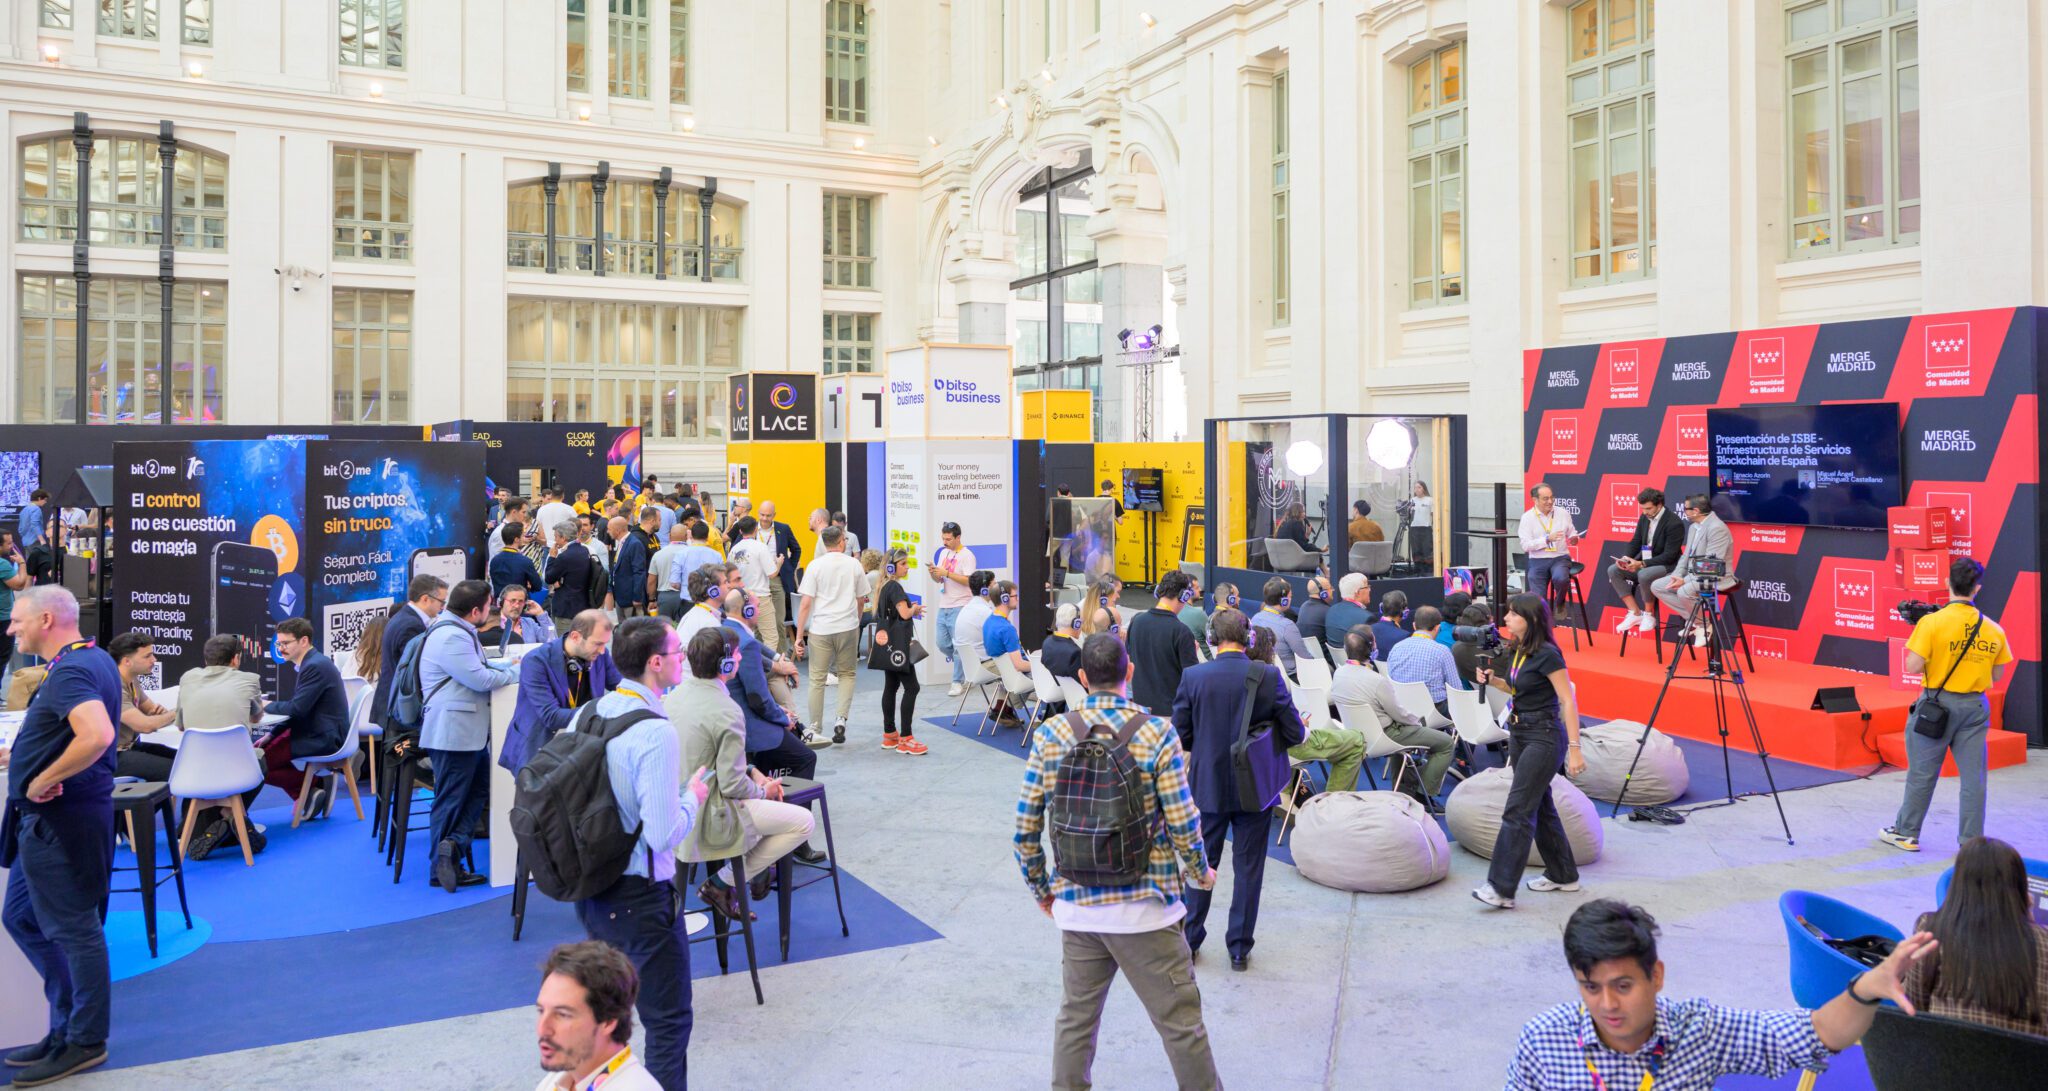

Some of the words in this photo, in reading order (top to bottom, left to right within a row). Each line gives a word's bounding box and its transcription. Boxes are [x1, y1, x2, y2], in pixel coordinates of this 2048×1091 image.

[1830, 351, 1870, 363] MERGE
[1674, 362, 1707, 372] MERGE
[1827, 361, 1876, 373] MADRID
[1549, 370, 1576, 380] MERGE
[1672, 370, 1711, 381] MADRID
[1925, 370, 1970, 378] Comunidad
[897, 381, 912, 393] bitso
[946, 379, 977, 391] bitso
[1547, 378, 1580, 388] MADRID
[1939, 378, 1970, 386] Madrid
[897, 393, 924, 406] business
[946, 393, 1000, 404] business
[733, 416, 748, 431] LACE
[761, 415, 808, 431] LACE
[472, 432, 490, 440] EAD
[566, 431, 595, 440] CLOAK
[1609, 434, 1639, 442] MERGE
[1715, 434, 1776, 444] Presentación
[1777, 434, 1790, 444] de
[1791, 433, 1817, 444] ISBE
[1924, 430, 1970, 441] MERGE
[567, 439, 595, 447] ROOM
[1607, 441, 1643, 451] MADRID
[1921, 440, 1976, 451] MADRID
[1715, 445, 1789, 455] Infraestructura
[1790, 445, 1803, 455] de
[1804, 444, 1851, 455] Servicios
[938, 463, 954, 471] Your
[955, 464, 980, 472] money
[1716, 456, 1766, 466] Blockchain
[1767, 456, 1780, 466] de
[1781, 456, 1818, 468] España
[131, 459, 176, 479] bit2me
[323, 459, 371, 479] bit2me
[938, 473, 969, 482] traveling
[938, 482, 961, 490] LatAm
[962, 482, 976, 490] and
[977, 482, 1003, 491] Europe
[131, 493, 144, 507] El
[146, 493, 201, 508] control
[324, 494, 351, 510] Tus
[353, 492, 408, 510] criptos.
[962, 492, 981, 500] time.
[131, 518, 149, 531] no
[152, 517, 169, 531] es
[172, 514, 236, 532] cuestión
[324, 517, 347, 534] sin
[349, 517, 394, 532] truco.
[1751, 528, 1786, 536] Comunidad
[1762, 536, 1786, 544] Madrid
[131, 538, 150, 554] de
[152, 538, 197, 557] magia
[1949, 548, 1972, 556] adrid
[324, 554, 367, 570] Seguro.
[323, 569, 377, 586] Completo
[1750, 580, 1787, 593] MERGE
[131, 591, 177, 605] Potencia
[178, 592, 190, 605] tu
[1747, 589, 1791, 602] MADRID
[131, 609, 186, 624] estrategia
[1835, 611, 1874, 622] Comunidad
[1835, 619, 1845, 627] de
[1847, 620, 1874, 630] Madrid
[131, 626, 151, 638] con
[152, 625, 193, 642] Trading
[150, 643, 182, 656] nzado
